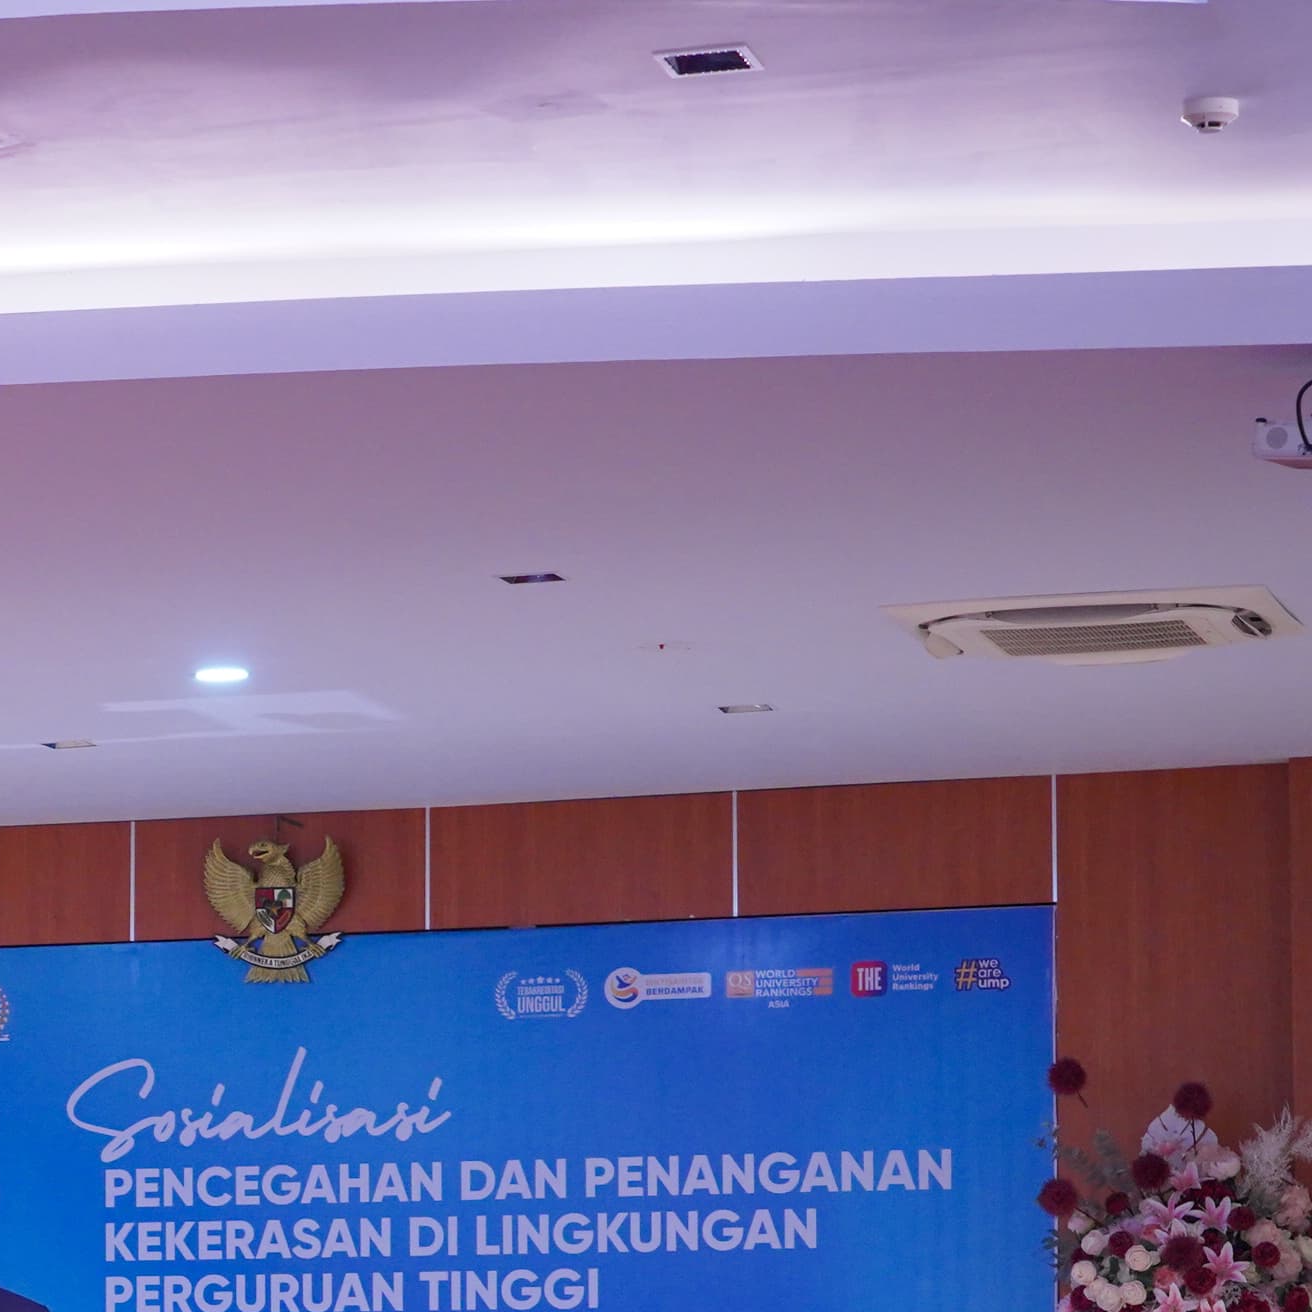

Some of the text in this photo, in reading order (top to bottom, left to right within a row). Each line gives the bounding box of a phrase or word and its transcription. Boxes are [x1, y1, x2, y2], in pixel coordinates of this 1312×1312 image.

[892, 964, 920, 972] World
[978, 960, 998, 968] we
[756, 970, 796, 979] WORLD
[892, 972, 939, 982] University
[978, 968, 1001, 977] are
[756, 978, 818, 988] UNIVERSITY
[856, 967, 882, 991] THE
[892, 983, 934, 992] Rankings
[978, 979, 1009, 990] ump
[756, 986, 813, 997] RANKINGS
[518, 996, 566, 1013] UNGGUL
[768, 1000, 790, 1009] ASIA
[66, 1046, 452, 1162] Sosialisasi
[104, 1149, 952, 1208] PENCEGAHAN DAN PENANGANAN
[105, 1208, 817, 1262] KEKERASAN DI LINGKUNGAN
[420, 1268, 598, 1312] TINGGI
